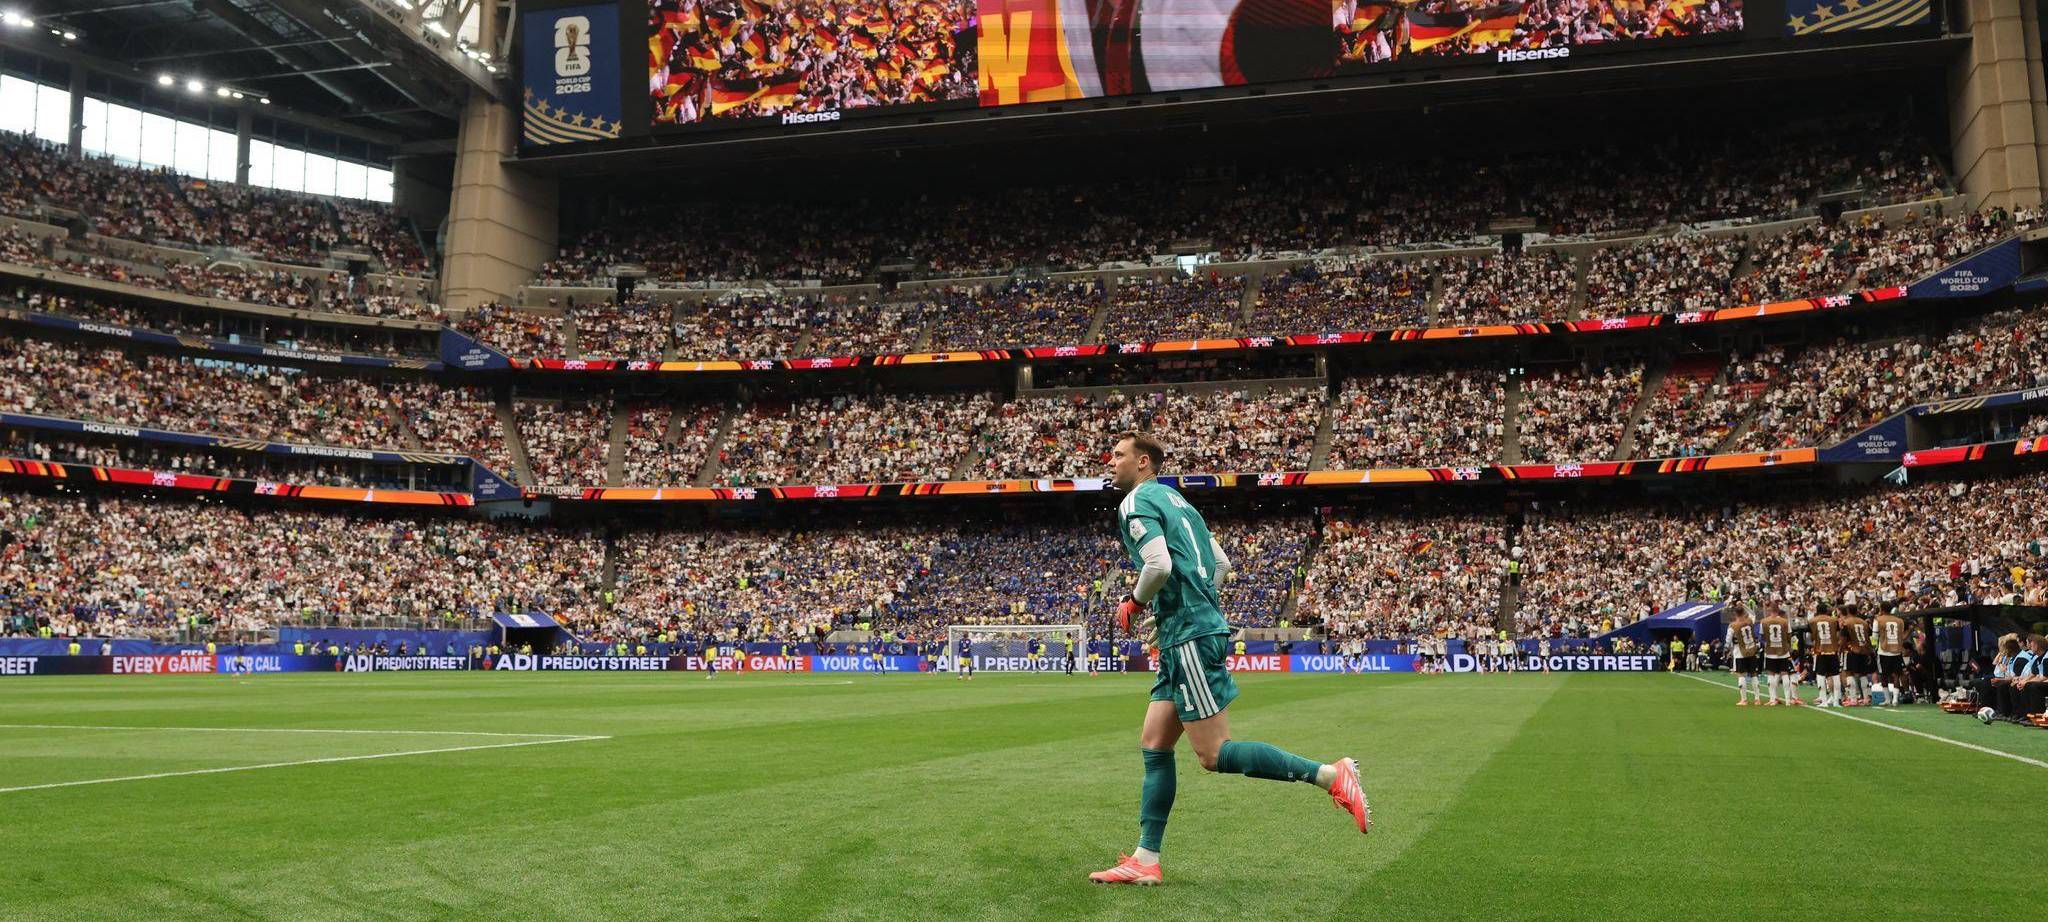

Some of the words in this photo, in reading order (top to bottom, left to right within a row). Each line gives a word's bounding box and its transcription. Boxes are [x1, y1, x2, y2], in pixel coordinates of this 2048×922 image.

[1498, 48, 1570, 62] Hisense
[556, 83, 591, 94] 2026
[782, 111, 840, 124] Hisense
[79, 322, 132, 336] HOUSTON
[2022, 390, 2037, 400] FIFA
[83, 424, 139, 436] HOUSTON
[308, 448, 333, 456] WORLD
[1182, 517, 1207, 578] 1
[720, 647, 738, 655] FIF
[112, 656, 165, 674] EVERY
[168, 656, 212, 672] GAME
[255, 656, 281, 671] CALL
[344, 655, 373, 672] ADI
[376, 656, 466, 670] PREDICTSTREET
[496, 654, 537, 671] ADI
[542, 656, 670, 670] PREDICTSTREET
[821, 657, 859, 670] YOUR
[1225, 656, 1281, 671] GAME
[1301, 656, 1345, 670] YOUR
[1349, 656, 1390, 671] CALL
[1490, 655, 1656, 670] PDCTSTREET
[1180, 684, 1194, 712] 1
